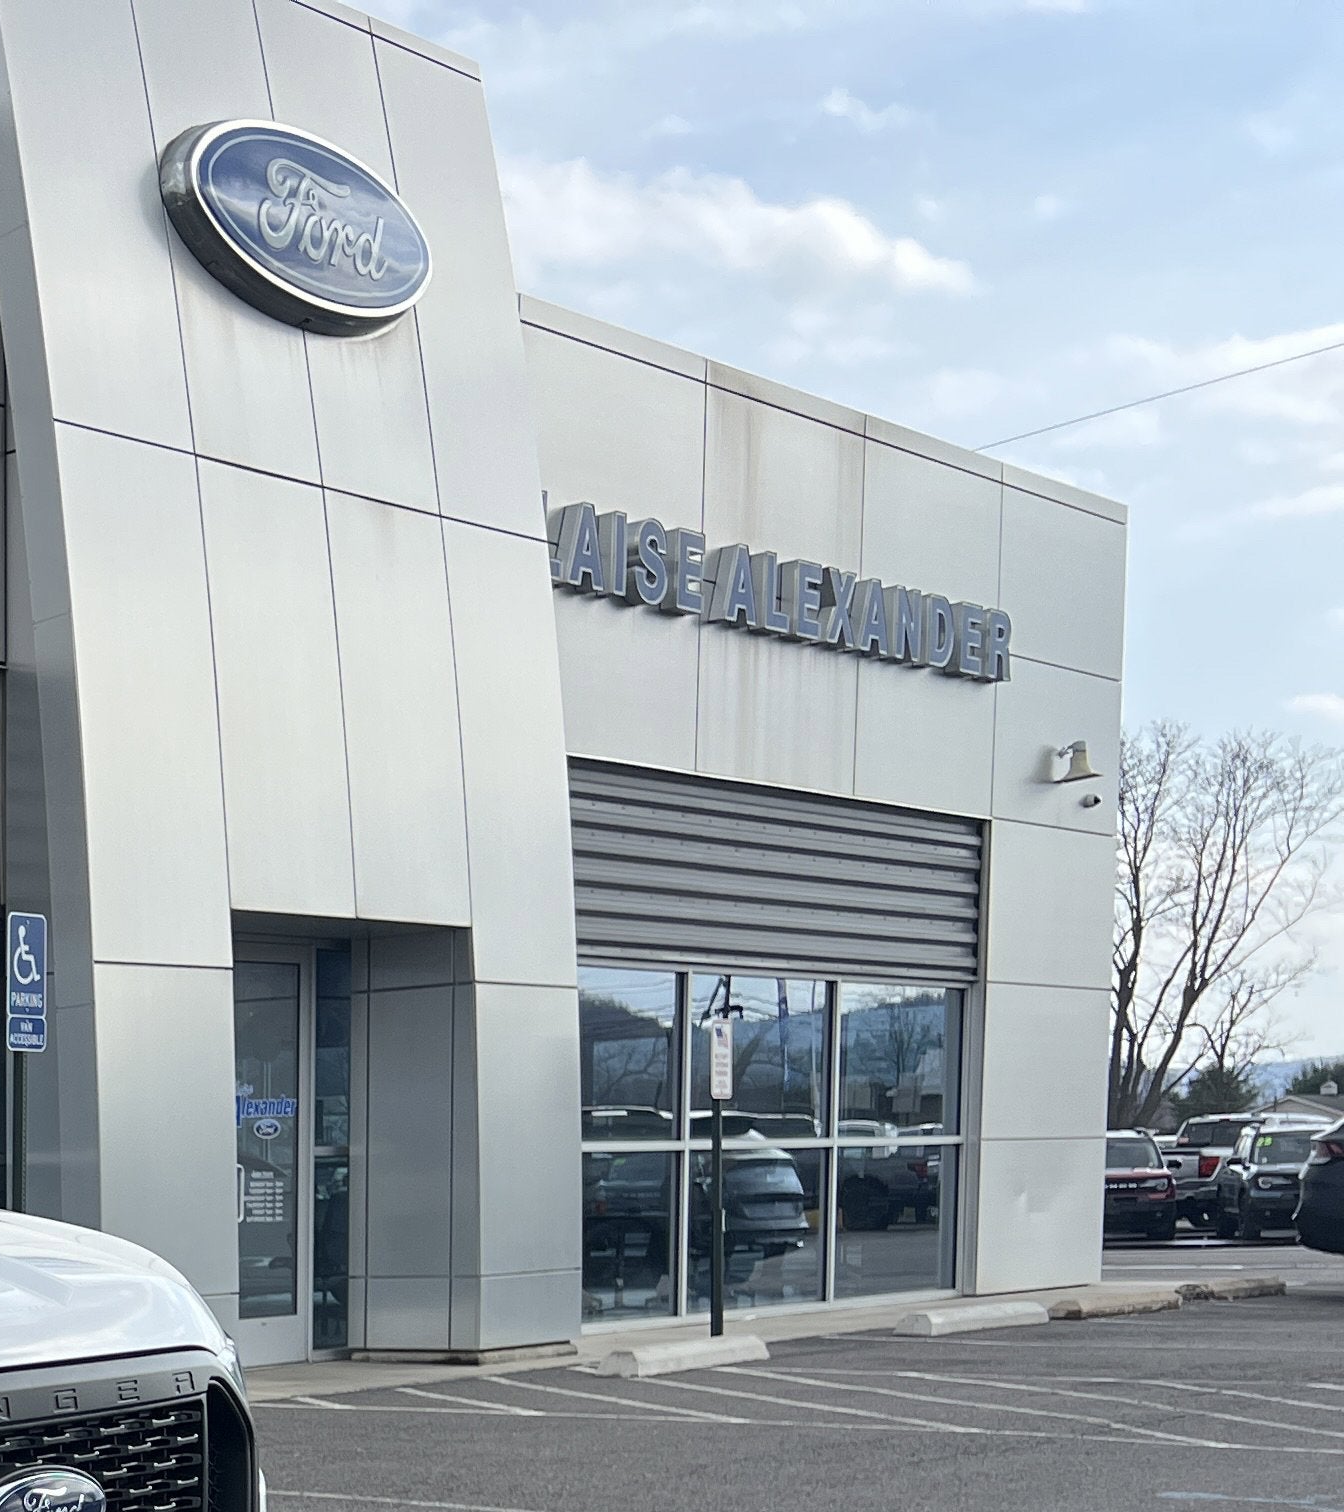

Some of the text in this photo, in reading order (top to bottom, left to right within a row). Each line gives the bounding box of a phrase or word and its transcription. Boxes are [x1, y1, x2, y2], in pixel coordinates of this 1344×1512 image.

[258, 157, 391, 282] Ford
[710, 543, 1011, 682] ALEXANDER
[11, 991, 43, 1009] PARKING
[20, 1021, 33, 1032] VAN
